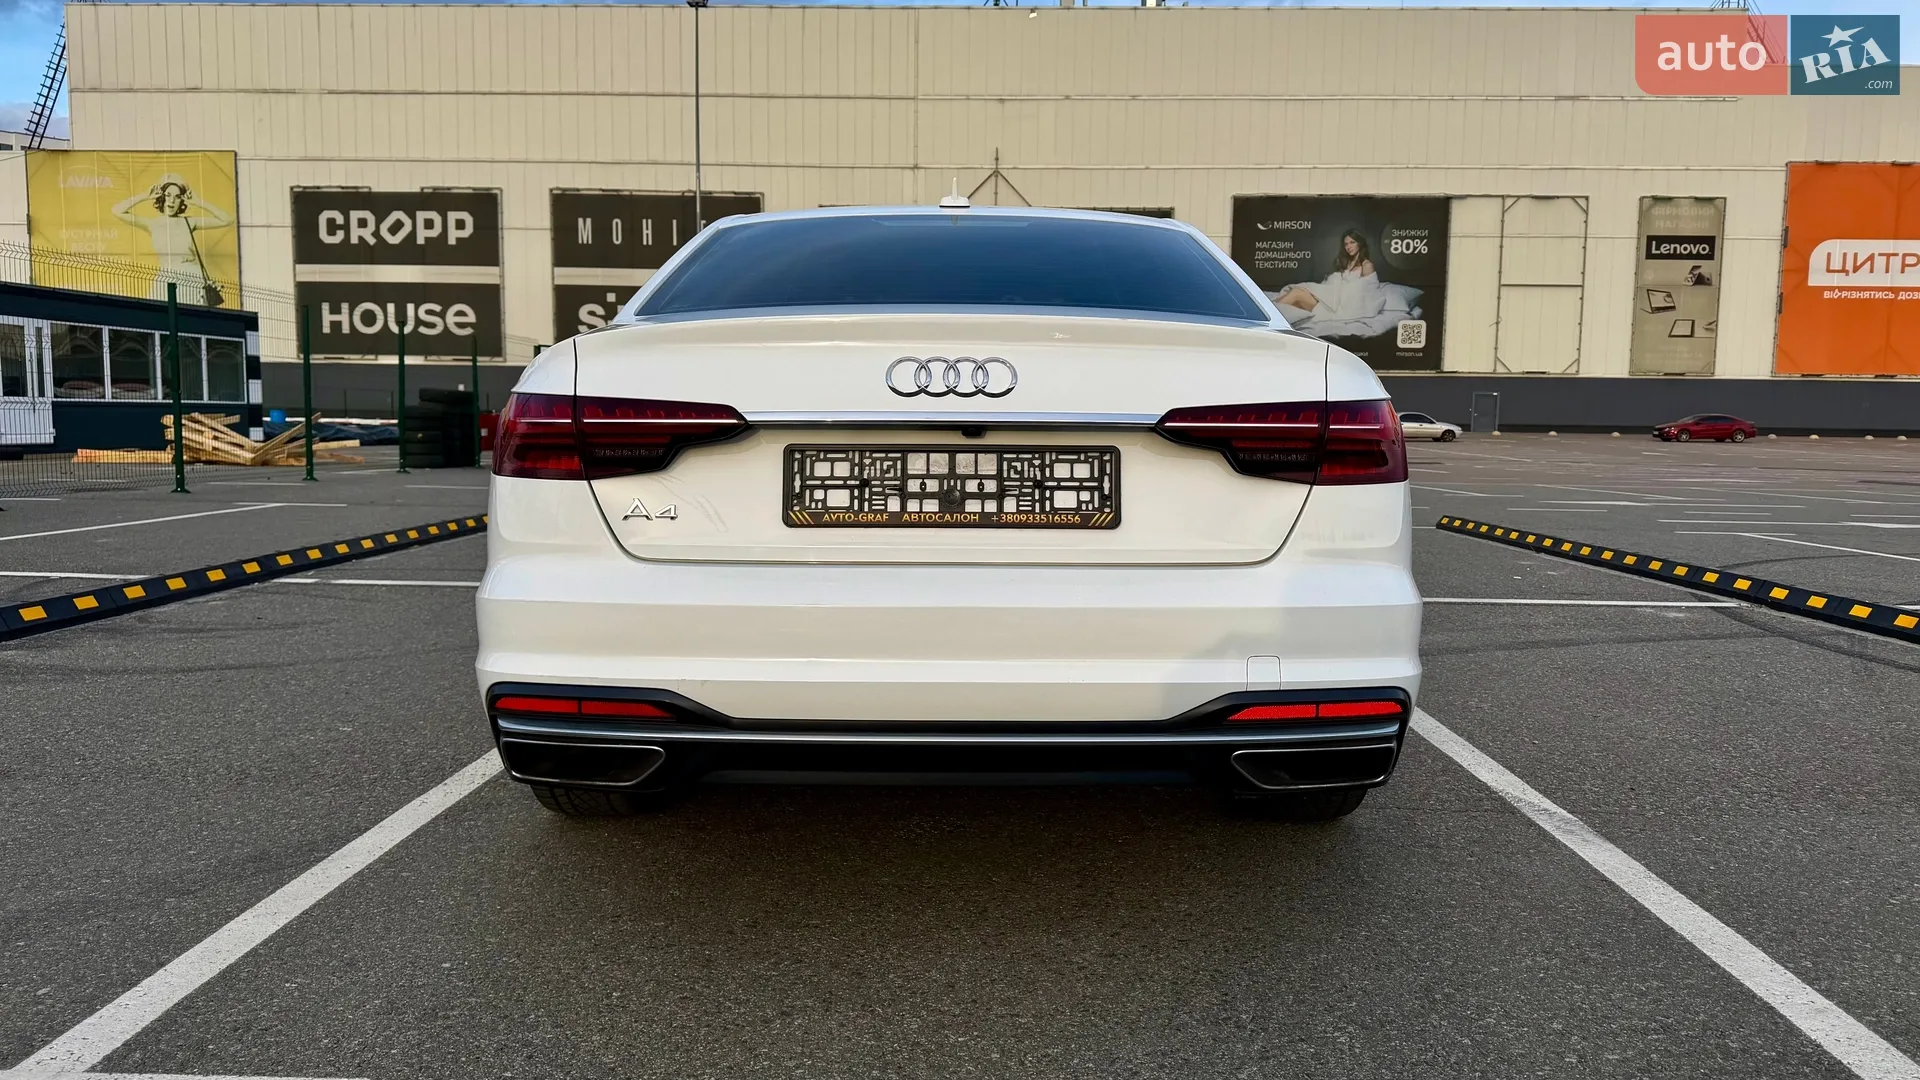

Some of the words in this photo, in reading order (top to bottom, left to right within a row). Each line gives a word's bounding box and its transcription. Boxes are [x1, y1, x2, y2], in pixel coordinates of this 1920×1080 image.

[318, 210, 474, 245] CROPP
[1273, 221, 1312, 230] MIRSON
[1391, 229, 1429, 237] ЗНИЖКИ
[1255, 241, 1294, 249] МАГАЗИН
[1390, 239, 1428, 254] 80%
[1651, 240, 1710, 255] Lenovo
[1254, 251, 1312, 259] ДОМАШНЬОГО
[1254, 261, 1299, 269] ТЕКСТИЛЮ
[1825, 252, 1920, 276] ЦИТР
[622, 498, 678, 521] A4
[822, 513, 889, 523] AVTO-GRAF
[902, 513, 979, 523] АВТОСАЛОН
[991, 514, 1081, 524] +380933516556
